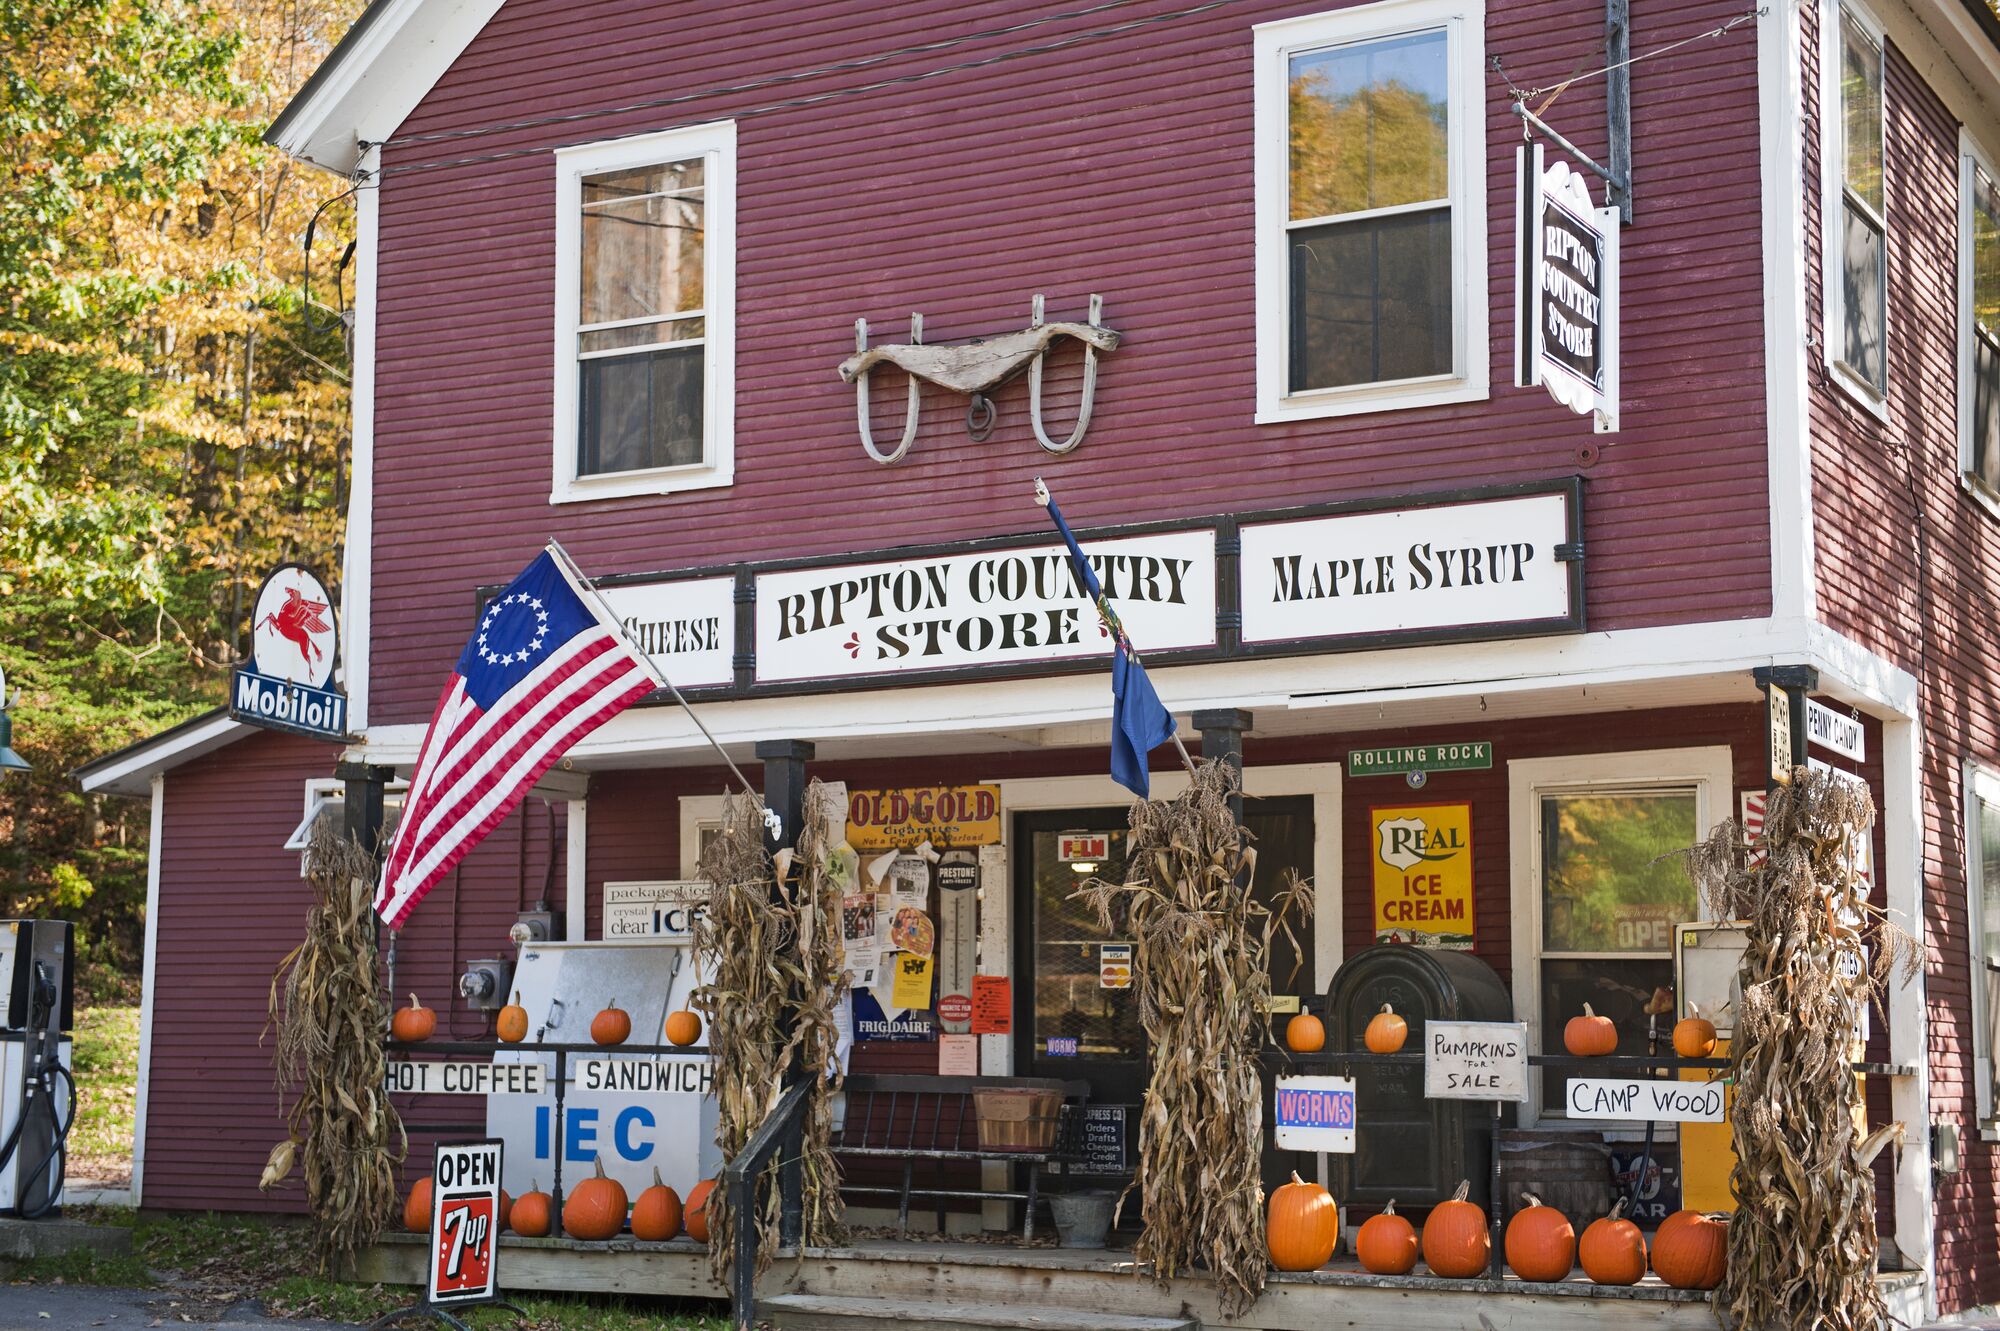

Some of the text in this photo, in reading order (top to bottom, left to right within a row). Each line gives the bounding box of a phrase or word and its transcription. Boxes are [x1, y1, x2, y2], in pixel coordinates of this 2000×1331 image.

[1546, 225, 1595, 288] RIPTON
[1542, 260, 1600, 326] COUNTRY
[1548, 301, 1593, 357] STORE
[1272, 542, 1534, 602] MAPLE SYRUP
[777, 555, 1194, 642] RIPTON COUNTRY
[621, 617, 719, 655] CHEESE
[877, 608, 1080, 660] STORE
[237, 675, 341, 730] Mobiloil
[1808, 706, 1858, 753] PENNY CANDY
[1353, 745, 1484, 766] ROLLING ROCK
[851, 793, 909, 827] OLD
[914, 790, 995, 824] GOLD
[884, 825, 960, 837] Cigarettes
[1391, 827, 1465, 861] REAL
[939, 867, 975, 878] PRESTONE
[611, 886, 711, 901] packaged ice
[1404, 874, 1442, 896] ICE
[613, 907, 648, 918] crystal
[1383, 899, 1464, 922] CREAM
[611, 919, 648, 935] clear
[859, 1021, 931, 1033] FRIGIDAIRE
[1048, 1040, 1077, 1054] WORMS
[1434, 1034, 1518, 1058] PUMPKINS
[385, 1063, 538, 1094] HOT COFFEE
[586, 1060, 715, 1093] SANDWICH
[1448, 1073, 1500, 1089] SALE
[1280, 1092, 1352, 1125] WORMS
[1572, 1082, 1720, 1116] CAMP WOOD
[1085, 1123, 1116, 1132] Orders
[1088, 1133, 1117, 1143] Drafts
[1086, 1143, 1121, 1153] Cheques
[1091, 1152, 1116, 1161] Credit
[439, 1152, 496, 1187] OPEN
[1089, 1161, 1122, 1171] Transfers
